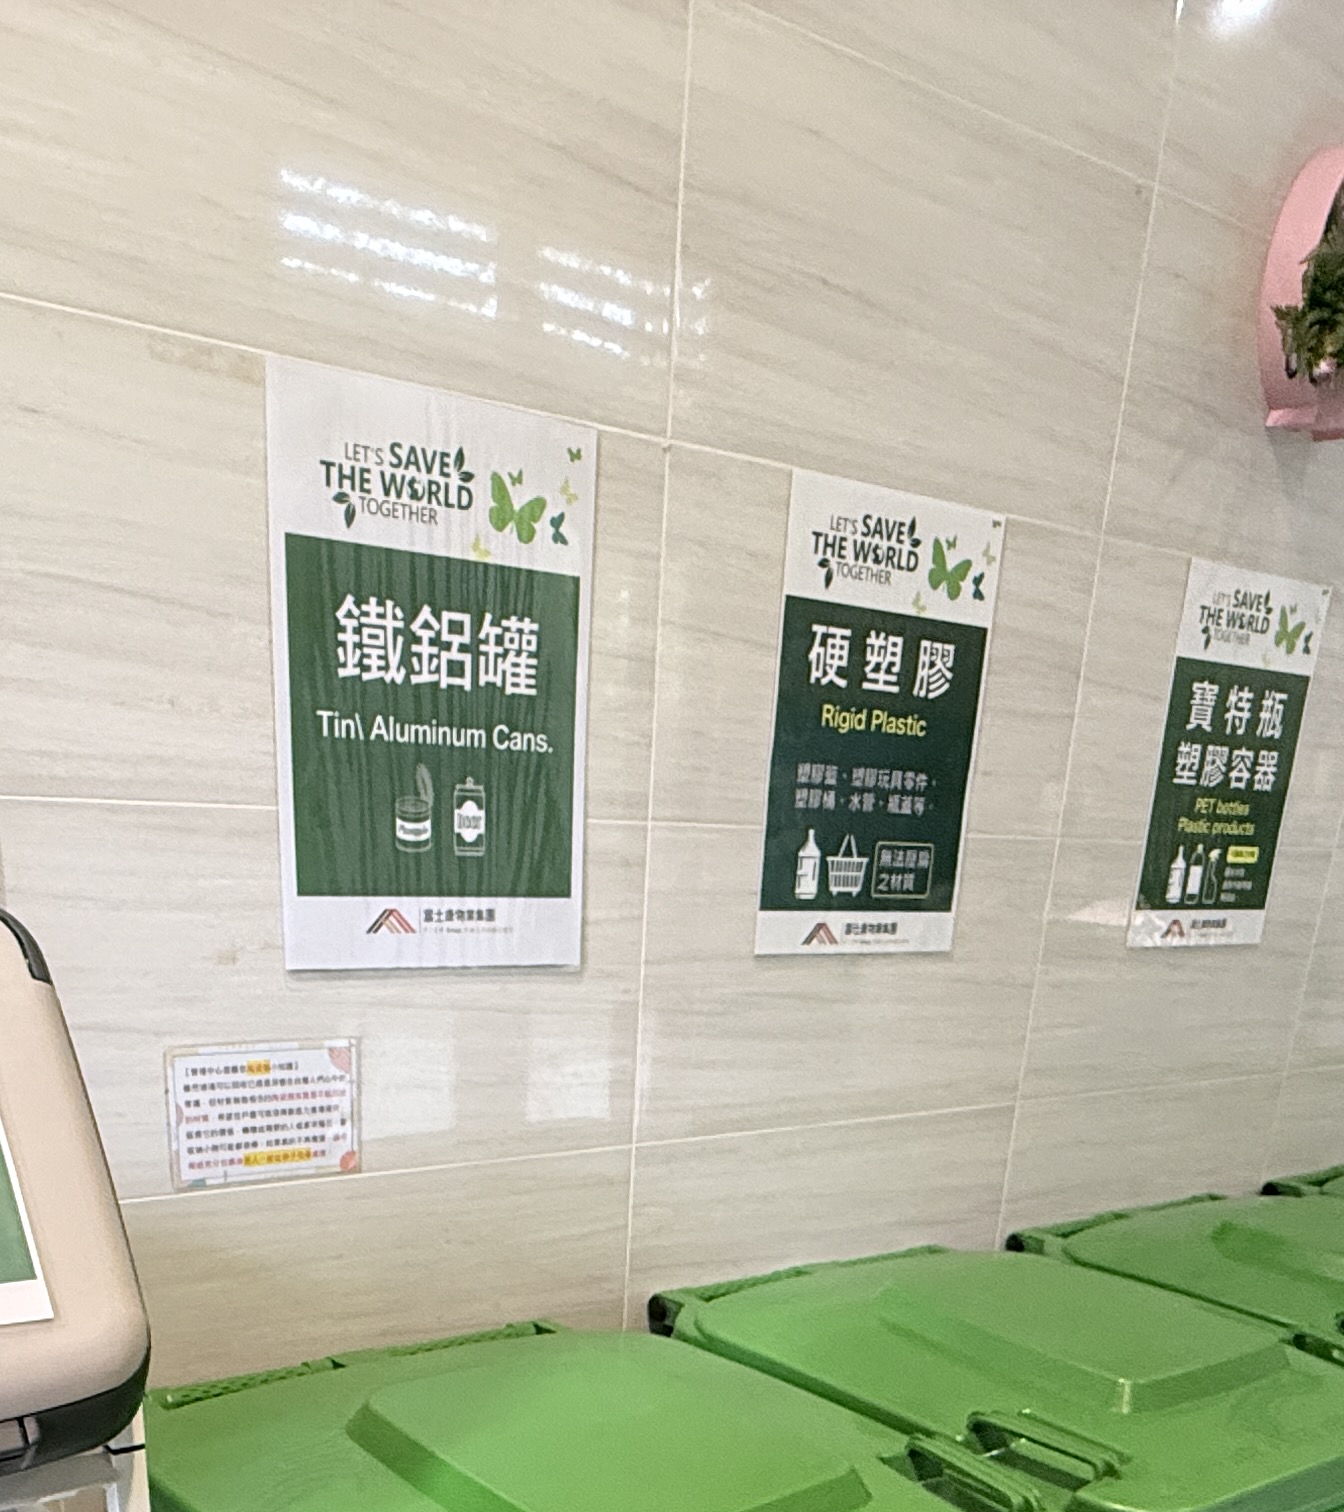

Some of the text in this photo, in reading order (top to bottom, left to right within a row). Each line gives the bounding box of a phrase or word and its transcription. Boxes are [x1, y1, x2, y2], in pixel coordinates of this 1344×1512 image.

[344, 441, 452, 478] LET'S SAVE
[320, 459, 474, 511] THE WORLD
[359, 496, 439, 526] TOGETHER
[861, 513, 906, 545] SAVE
[812, 531, 920, 572] THE WORLD
[836, 561, 892, 586] TOGETHER
[1199, 604, 1224, 627] THE
[334, 593, 540, 698] 鐵鋁罐
[808, 623, 956, 699] 硬塑膠
[821, 703, 927, 737] Rigid Plastic
[1185, 680, 1289, 740] 寶特瓶
[370, 714, 487, 749] Aluminum
[492, 723, 554, 753] Cans.
[1172, 741, 1280, 793] 塑膠容器
